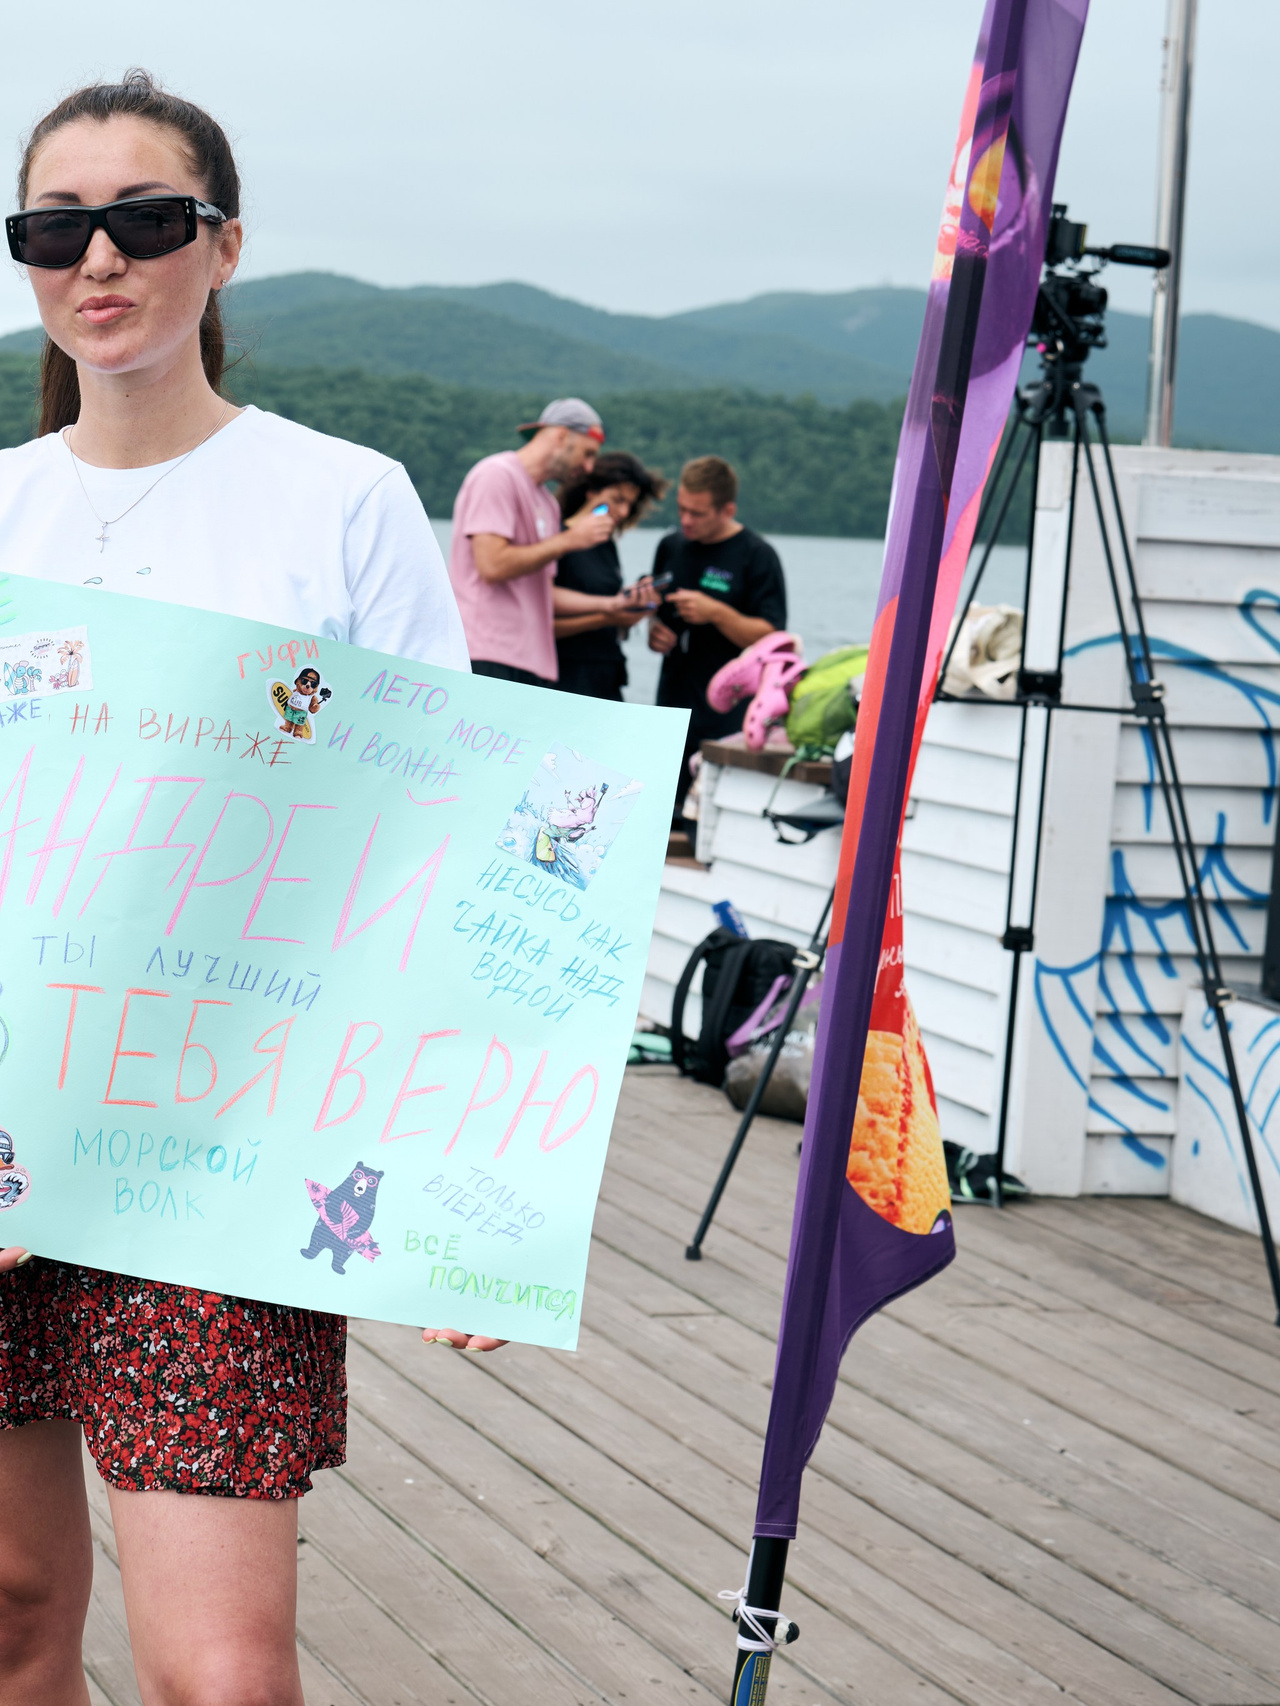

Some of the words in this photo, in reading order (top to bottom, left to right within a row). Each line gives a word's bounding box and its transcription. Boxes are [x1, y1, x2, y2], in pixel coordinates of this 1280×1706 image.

[237, 639, 320, 680] ГУФИ
[69, 703, 113, 735] НА
[139, 708, 296, 767] ВИРАЖЕ
[361, 669, 449, 716] ЛЕТО
[447, 717, 531, 766] МОРЕ
[328, 720, 354, 752] И
[358, 731, 462, 787] ВОЛНА
[476, 858, 581, 922] НЕСУСЬ
[577, 919, 633, 963] КАК
[32, 930, 96, 968] ТЫ
[146, 945, 322, 1011] ЛУЧШИЙ
[471, 951, 579, 1022] ВОДОЙ
[560, 956, 625, 1007] НАД
[46, 983, 297, 1120] ТЕБЯ
[312, 1014, 600, 1160] ВЕРЮ
[73, 1128, 262, 1184] МОРСКОЙ
[114, 1177, 206, 1220] ВОЛК
[469, 1166, 547, 1230] ТОЛЬКО
[404, 1230, 461, 1260] ВСЁ
[429, 1265, 578, 1321] ПОЛУЧИТСЯ
